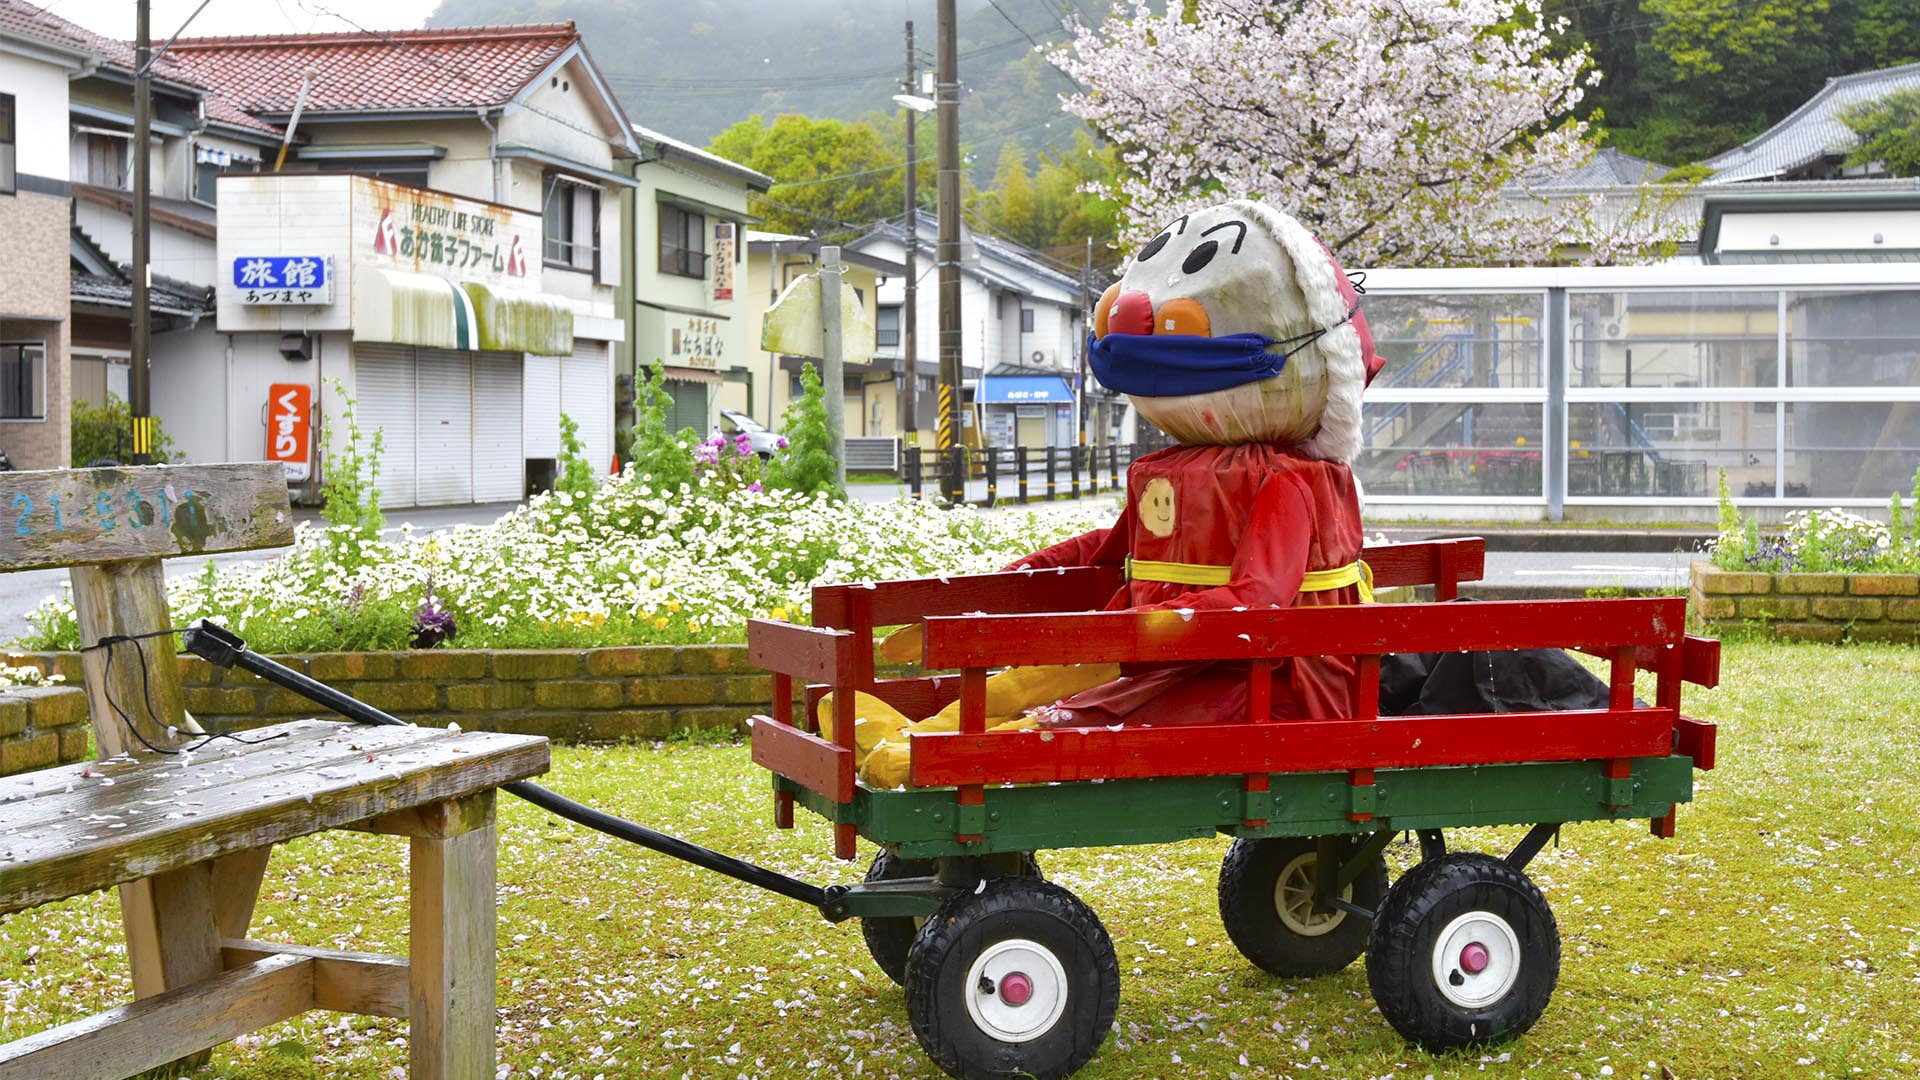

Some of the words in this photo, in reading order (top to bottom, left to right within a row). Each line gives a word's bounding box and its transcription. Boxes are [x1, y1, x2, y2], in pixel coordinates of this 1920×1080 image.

[411, 203, 450, 228] HEALTHY
[452, 211, 468, 232] LIFE
[471, 215, 496, 237] STORE
[240, 258, 318, 287] 旅館
[246, 290, 312, 303] あづまや
[275, 390, 301, 458] くすり
